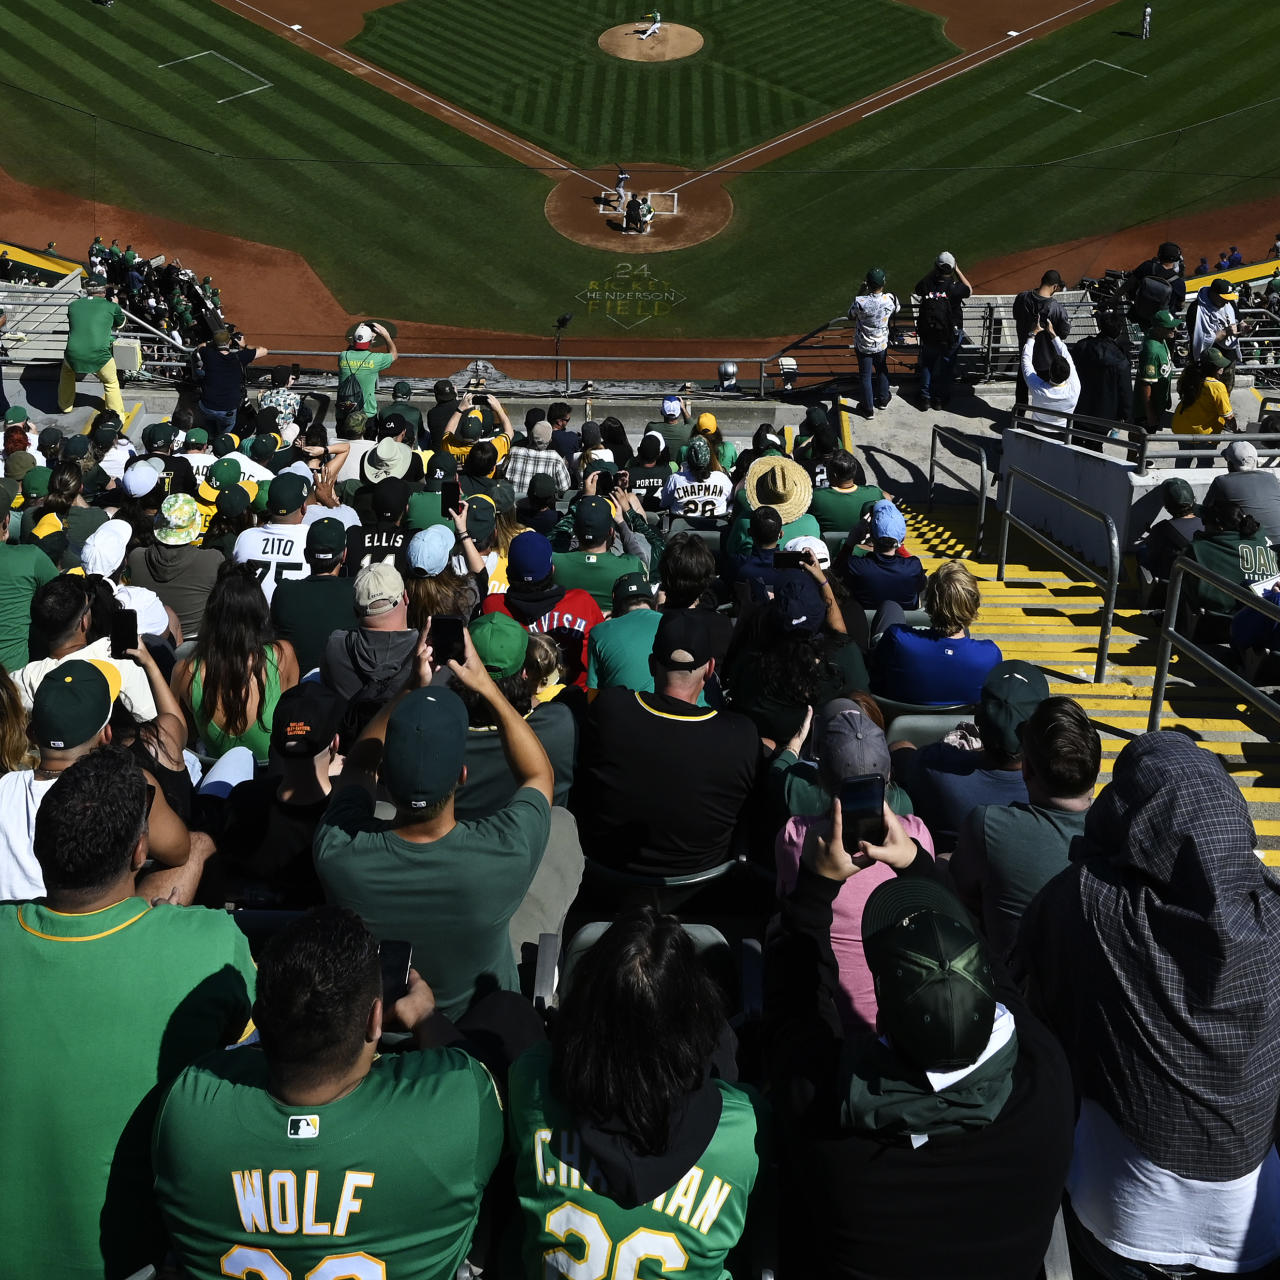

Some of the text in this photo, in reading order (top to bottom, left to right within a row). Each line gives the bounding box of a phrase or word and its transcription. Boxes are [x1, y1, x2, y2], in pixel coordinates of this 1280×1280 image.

[615, 263, 651, 278] 24
[588, 280, 671, 291] RICKEY
[587, 292, 675, 300] HENDERSON
[588, 300, 671, 315] FIELD
[636, 478, 663, 487] PORTER
[676, 483, 724, 498] CHAPMAN
[261, 538, 294, 557] ZITO
[365, 533, 404, 548] ELLIS
[231, 1169, 375, 1237] WOLF
